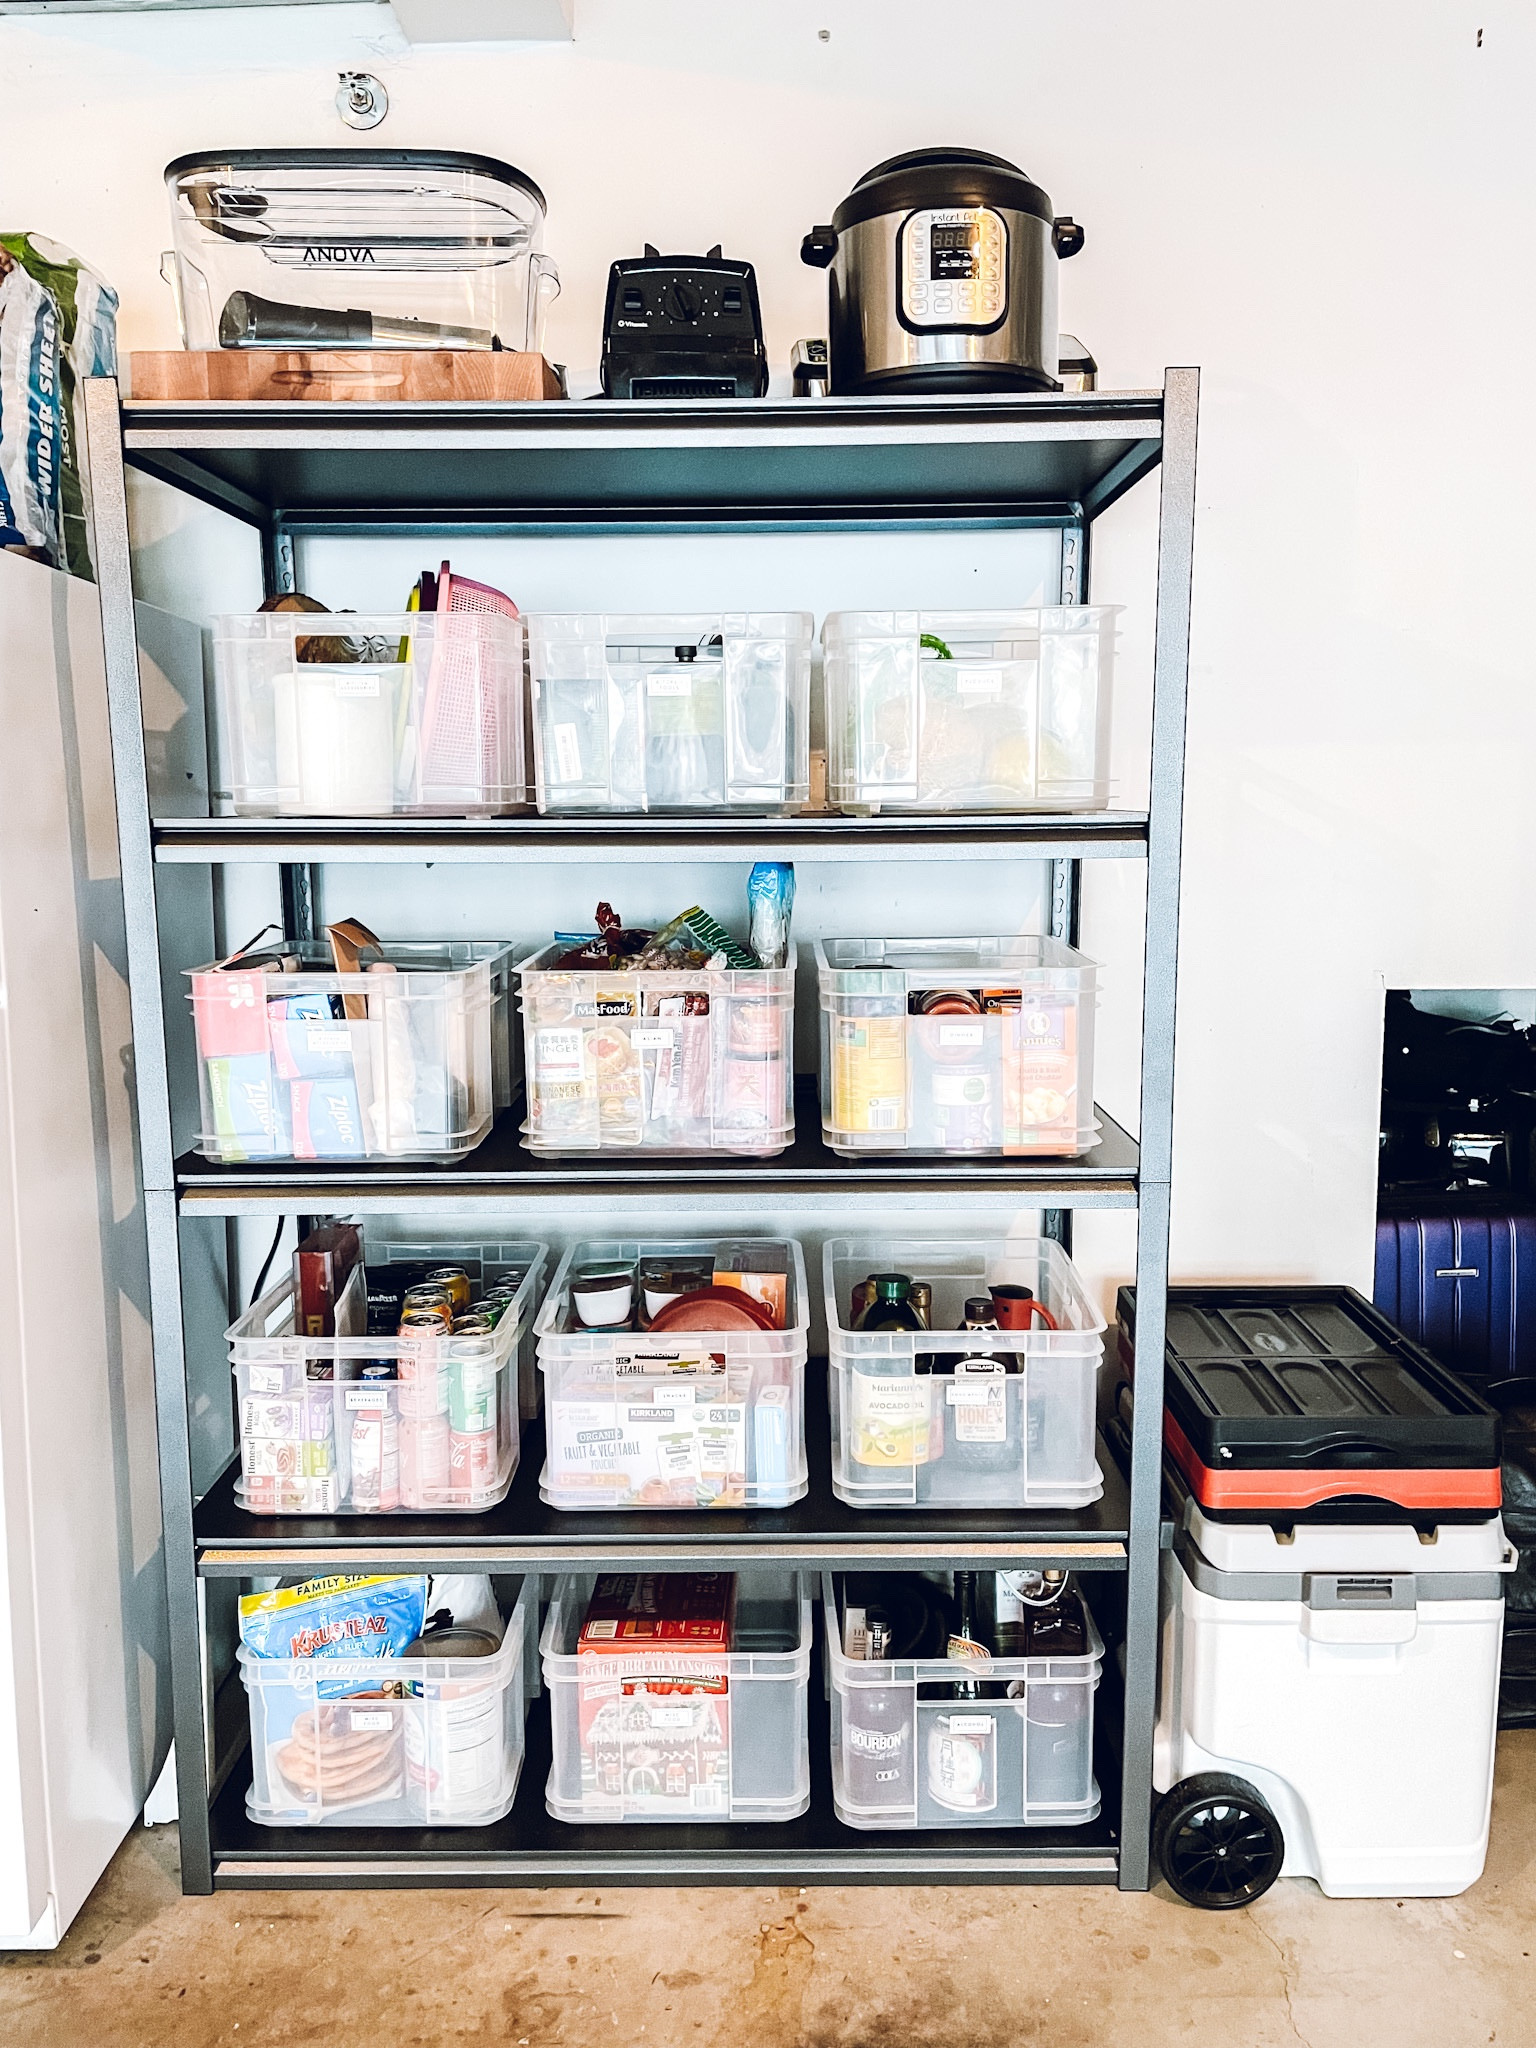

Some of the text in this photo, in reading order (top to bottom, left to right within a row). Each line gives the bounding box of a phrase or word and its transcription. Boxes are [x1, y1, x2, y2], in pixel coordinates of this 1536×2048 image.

[930, 212, 959, 222] Instant
[303, 247, 375, 262] ANOVA
[59, 405, 72, 469] MOST
[36, 404, 55, 497] WIDER
[1016, 1034, 1062, 1048] Annie's
[242, 1079, 280, 1137] Ziploc
[325, 1095, 356, 1145] Ziploc
[244, 1400, 255, 1435] Honest
[630, 1409, 673, 1418] KIRKLAND
[711, 1410, 723, 1421] 24
[957, 1407, 1004, 1425] HONEY
[247, 1440, 258, 1474] Honest
[563, 1444, 587, 1460] FRUIT
[588, 1443, 597, 1457] &
[321, 1479, 330, 1513] Honest
[297, 1577, 341, 1597] FAMILY
[291, 1616, 387, 1658] KRUSTEAZ
[344, 1640, 368, 1653] FLUFFY
[850, 1730, 902, 1751] BOURBON
